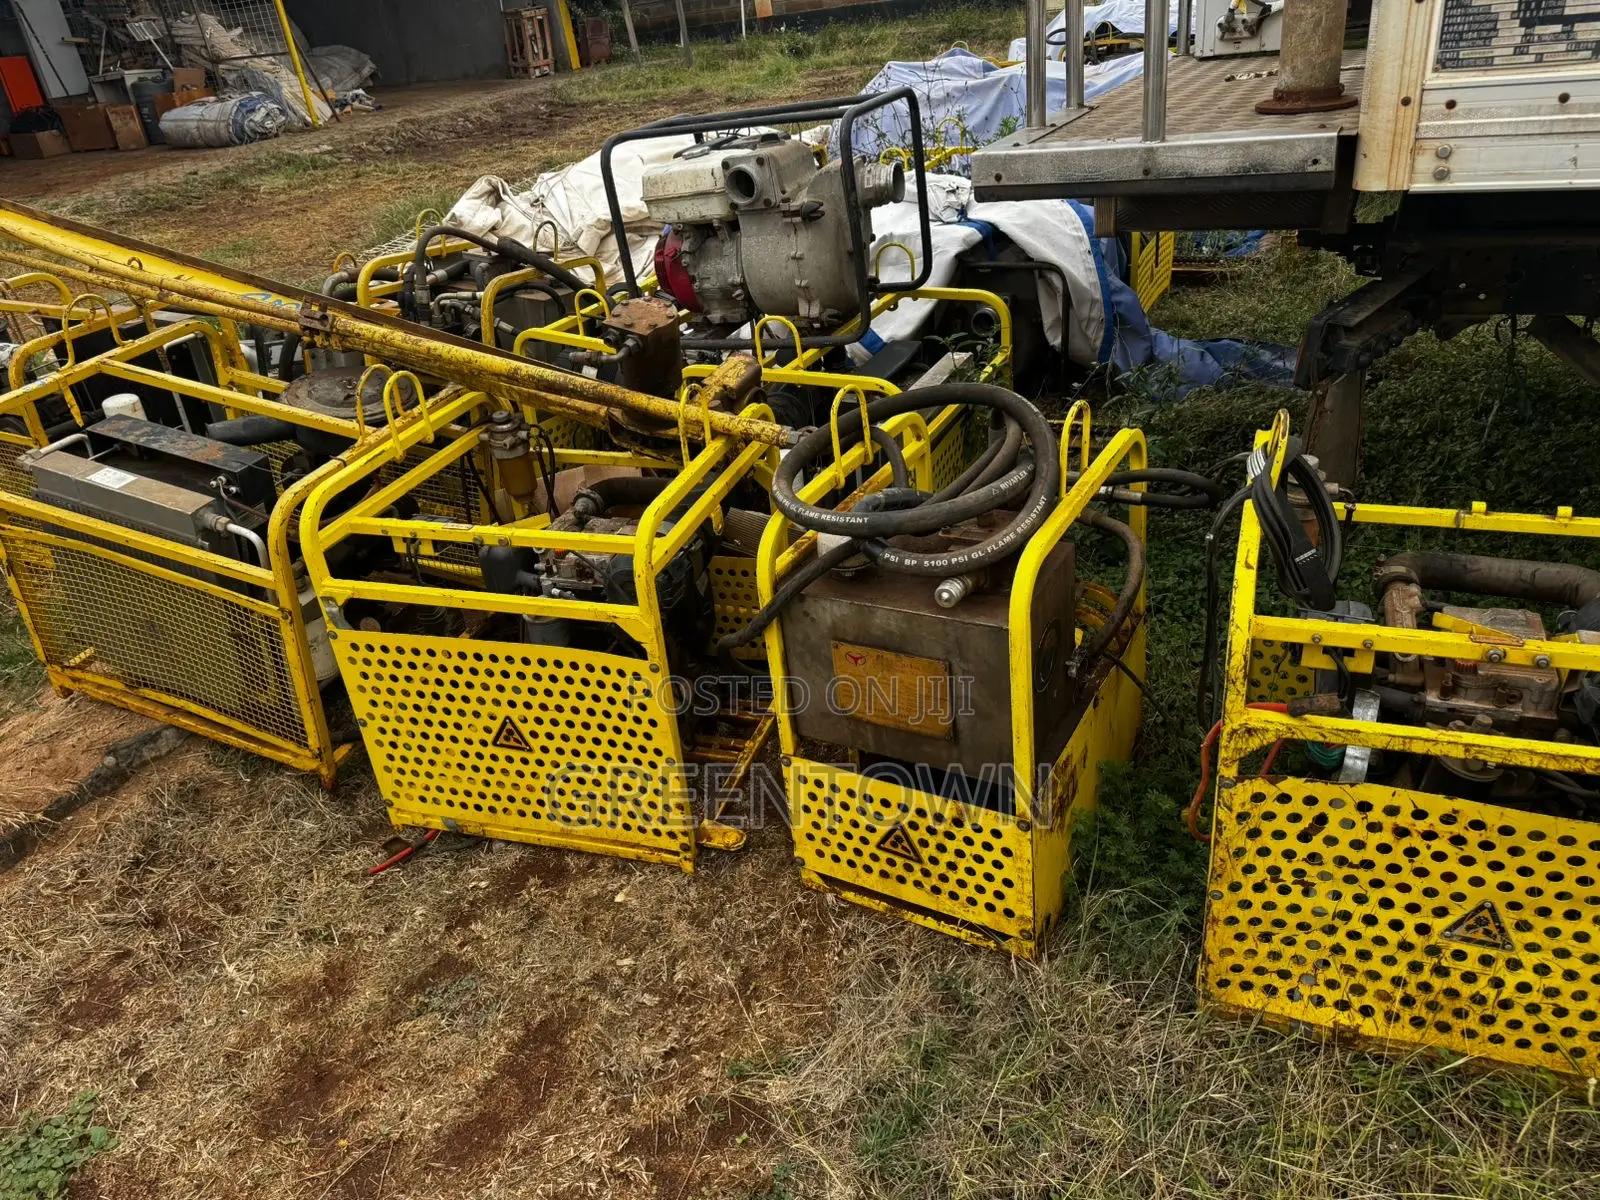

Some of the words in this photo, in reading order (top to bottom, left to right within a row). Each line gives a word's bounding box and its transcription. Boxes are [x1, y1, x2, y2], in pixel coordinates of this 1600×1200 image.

[797, 507, 820, 519] FLAME
[820, 512, 870, 524] RESISTANT
[883, 551, 900, 563] PSI
[923, 559, 949, 567] 5100
[951, 555, 969, 566] PSI
[971, 550, 986, 560] GL
[987, 531, 1017, 554] FLAME
[1016, 495, 1048, 535] RESISTANT
